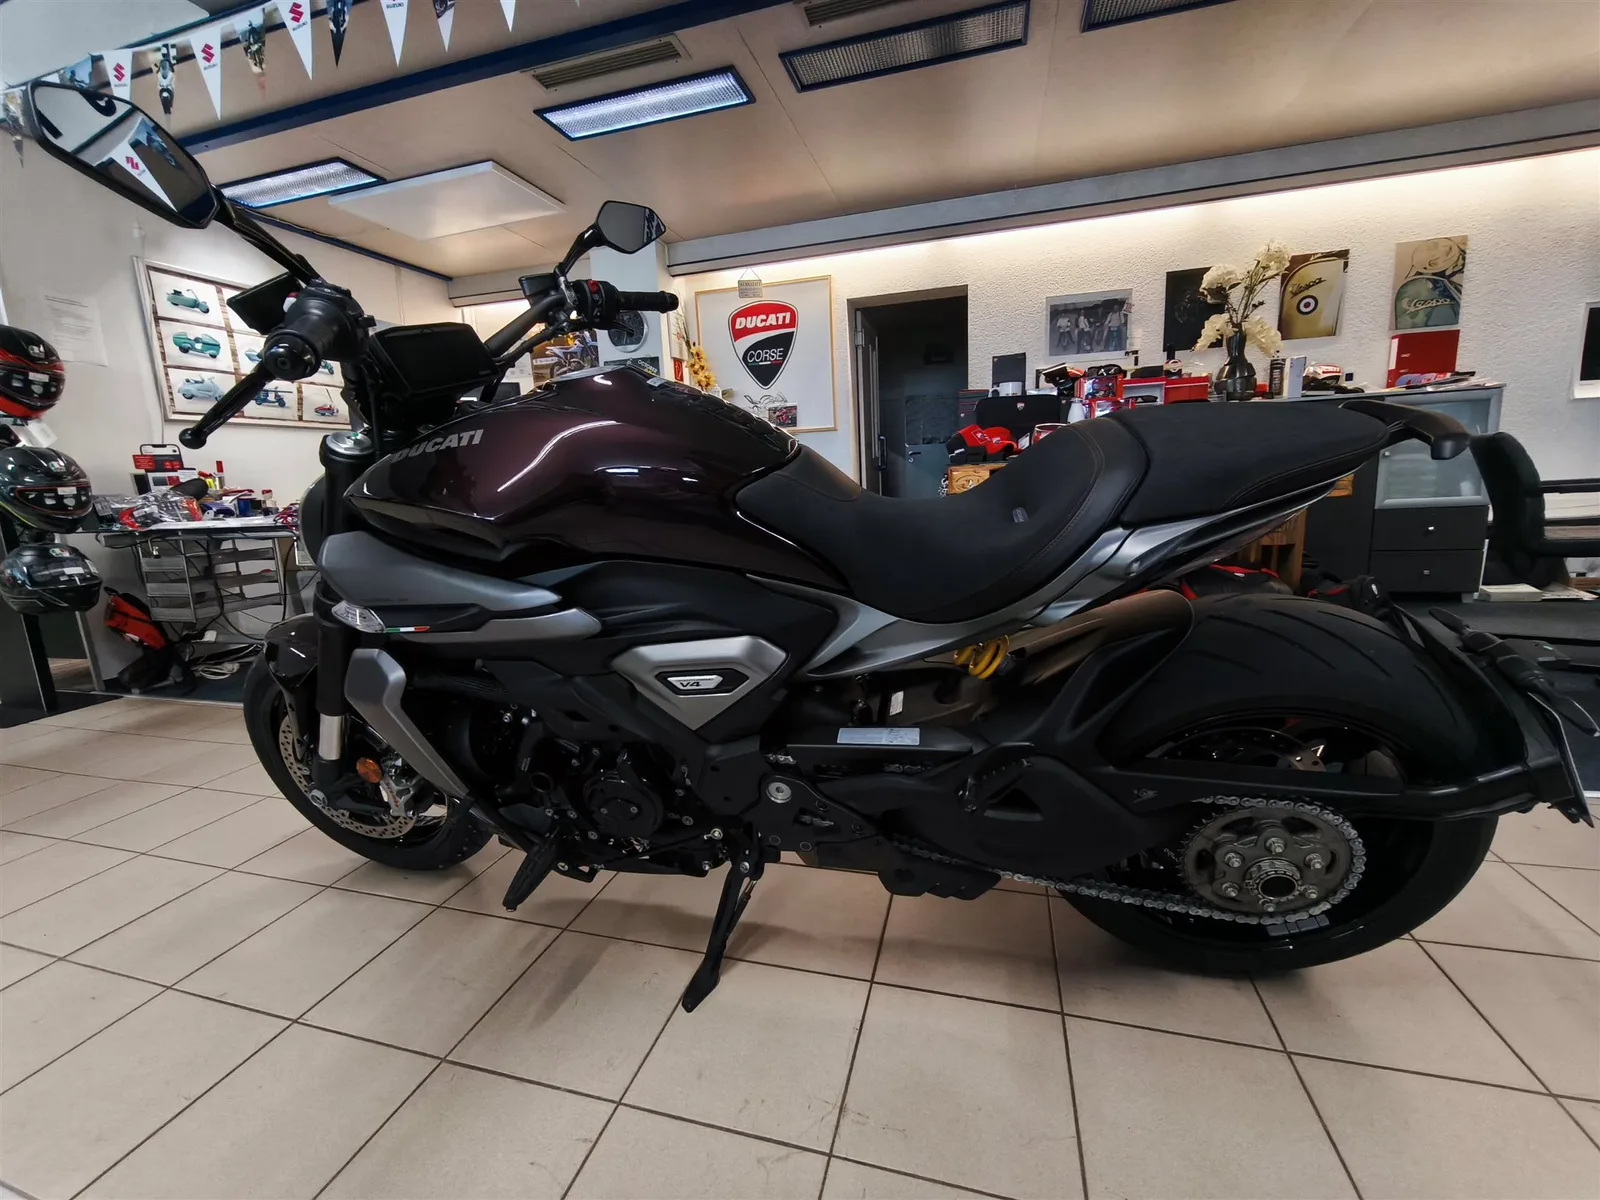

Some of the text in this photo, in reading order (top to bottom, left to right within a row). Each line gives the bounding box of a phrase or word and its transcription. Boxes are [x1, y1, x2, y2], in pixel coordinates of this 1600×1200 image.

[735, 312, 790, 329] DUCATI
[747, 348, 784, 362] CORSE
[637, 359, 657, 373] OCTOBER
[389, 429, 484, 464] DUCATI
